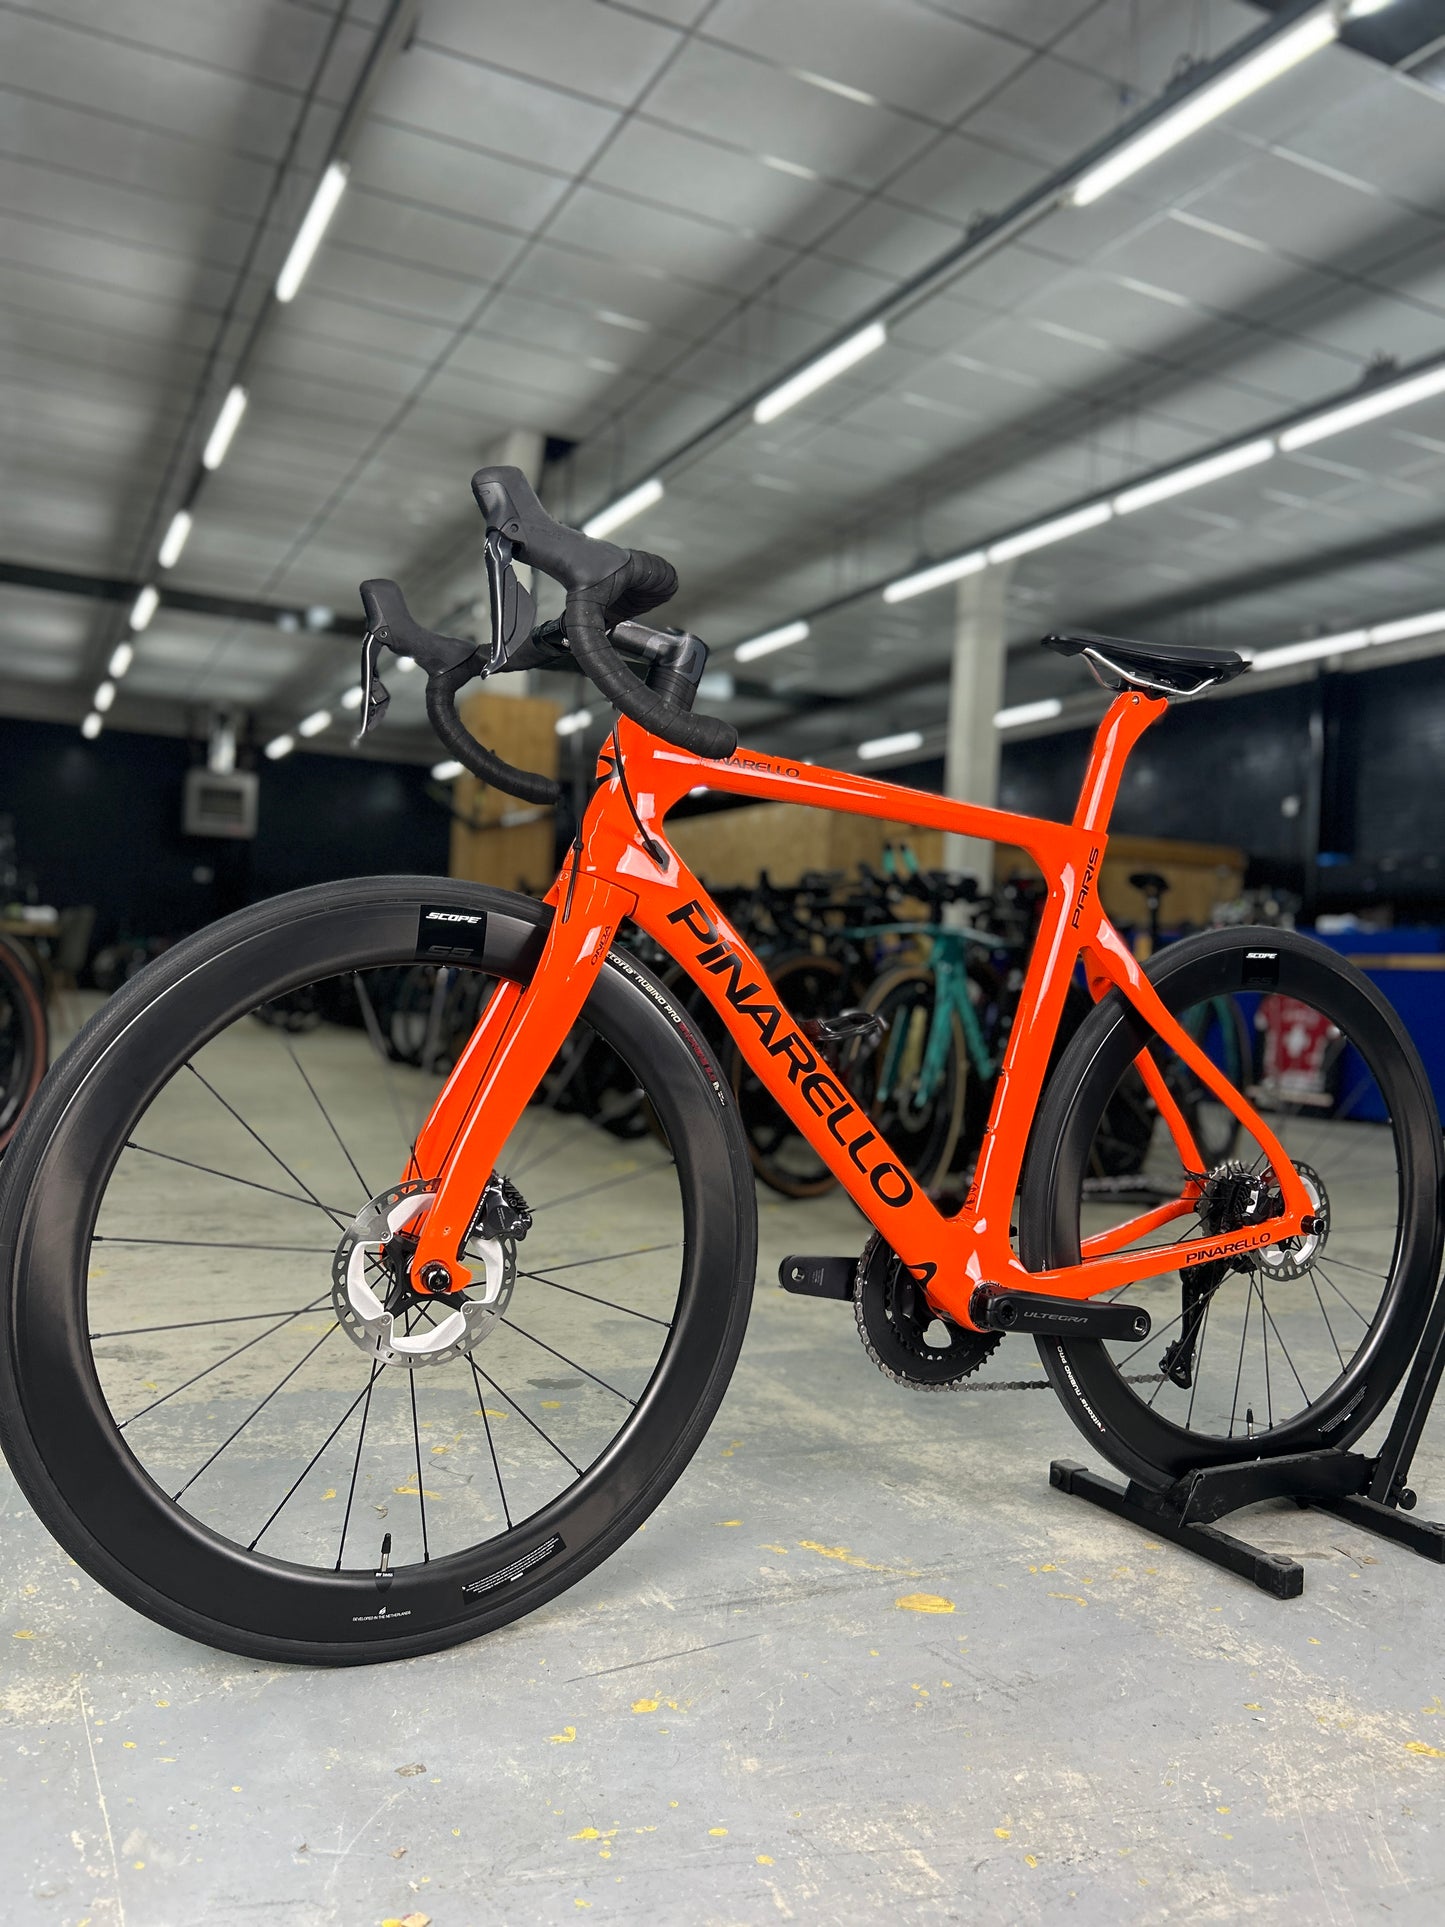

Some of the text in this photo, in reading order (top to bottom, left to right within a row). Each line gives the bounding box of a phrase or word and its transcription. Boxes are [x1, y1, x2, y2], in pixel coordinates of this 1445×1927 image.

[701, 757, 800, 778] NARELLO
[1072, 846, 1099, 929] PARIS
[425, 911, 482, 924] SCOPE
[606, 950, 682, 1023] ttoria RUBINO PRO
[666, 899, 914, 1208] PINARELLO
[1186, 1232, 1271, 1264] PINARELLO
[1023, 1311, 1089, 1324] ULTEGRA
[1057, 1345, 1068, 1364] PRO
